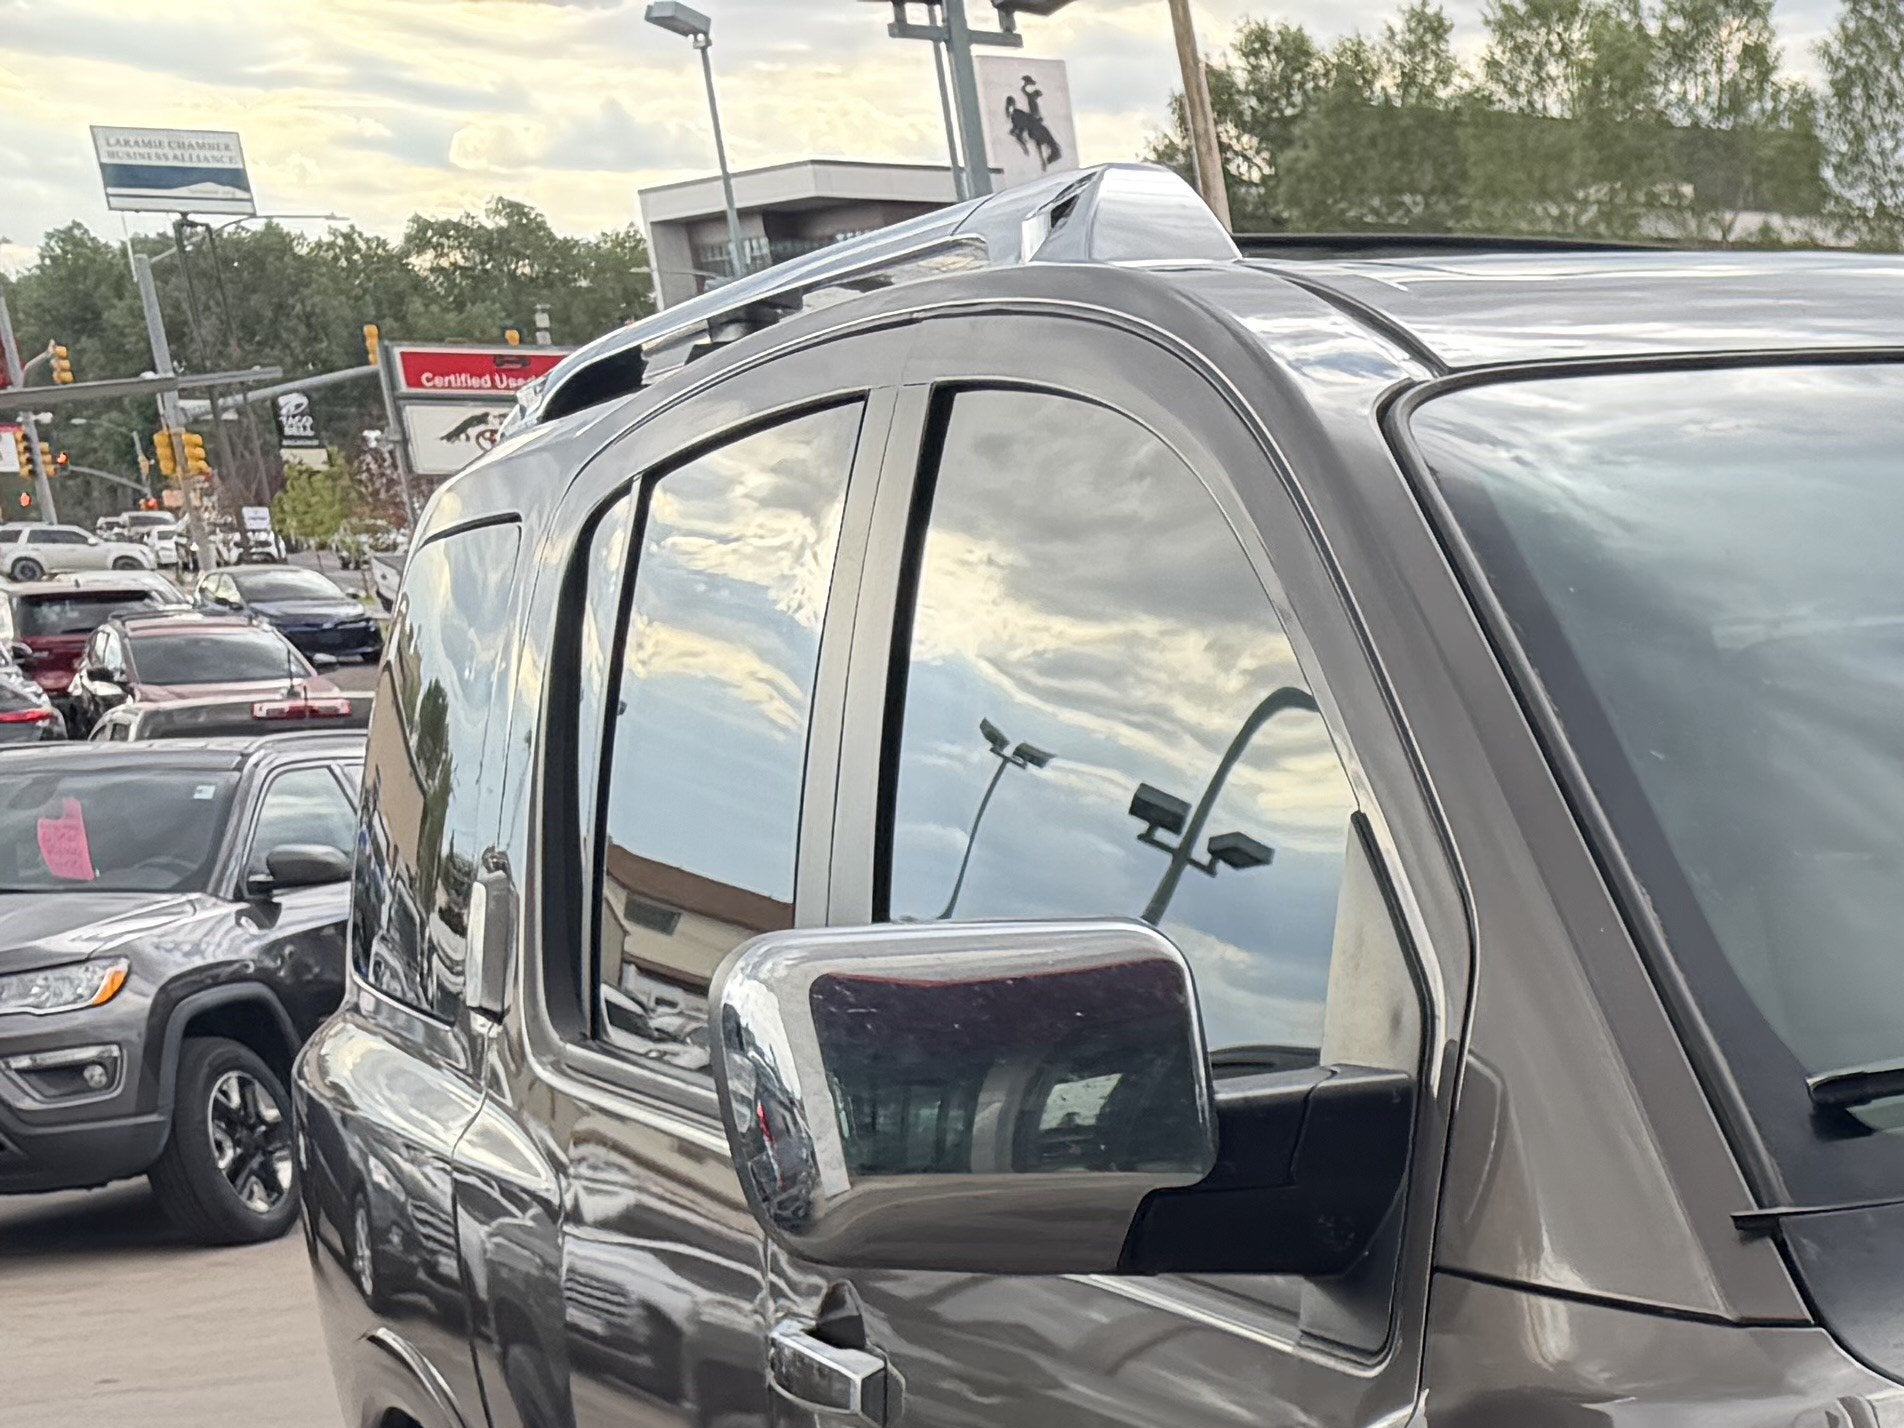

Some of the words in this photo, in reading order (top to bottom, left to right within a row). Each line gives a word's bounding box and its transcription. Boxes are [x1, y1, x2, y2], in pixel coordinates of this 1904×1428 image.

[105, 137, 166, 150] LARAMIE
[168, 139, 232, 152] CHAMBER
[106, 150, 170, 162] BUSINESS
[172, 151, 237, 164] ALLIANCE
[421, 372, 491, 388] Certified
